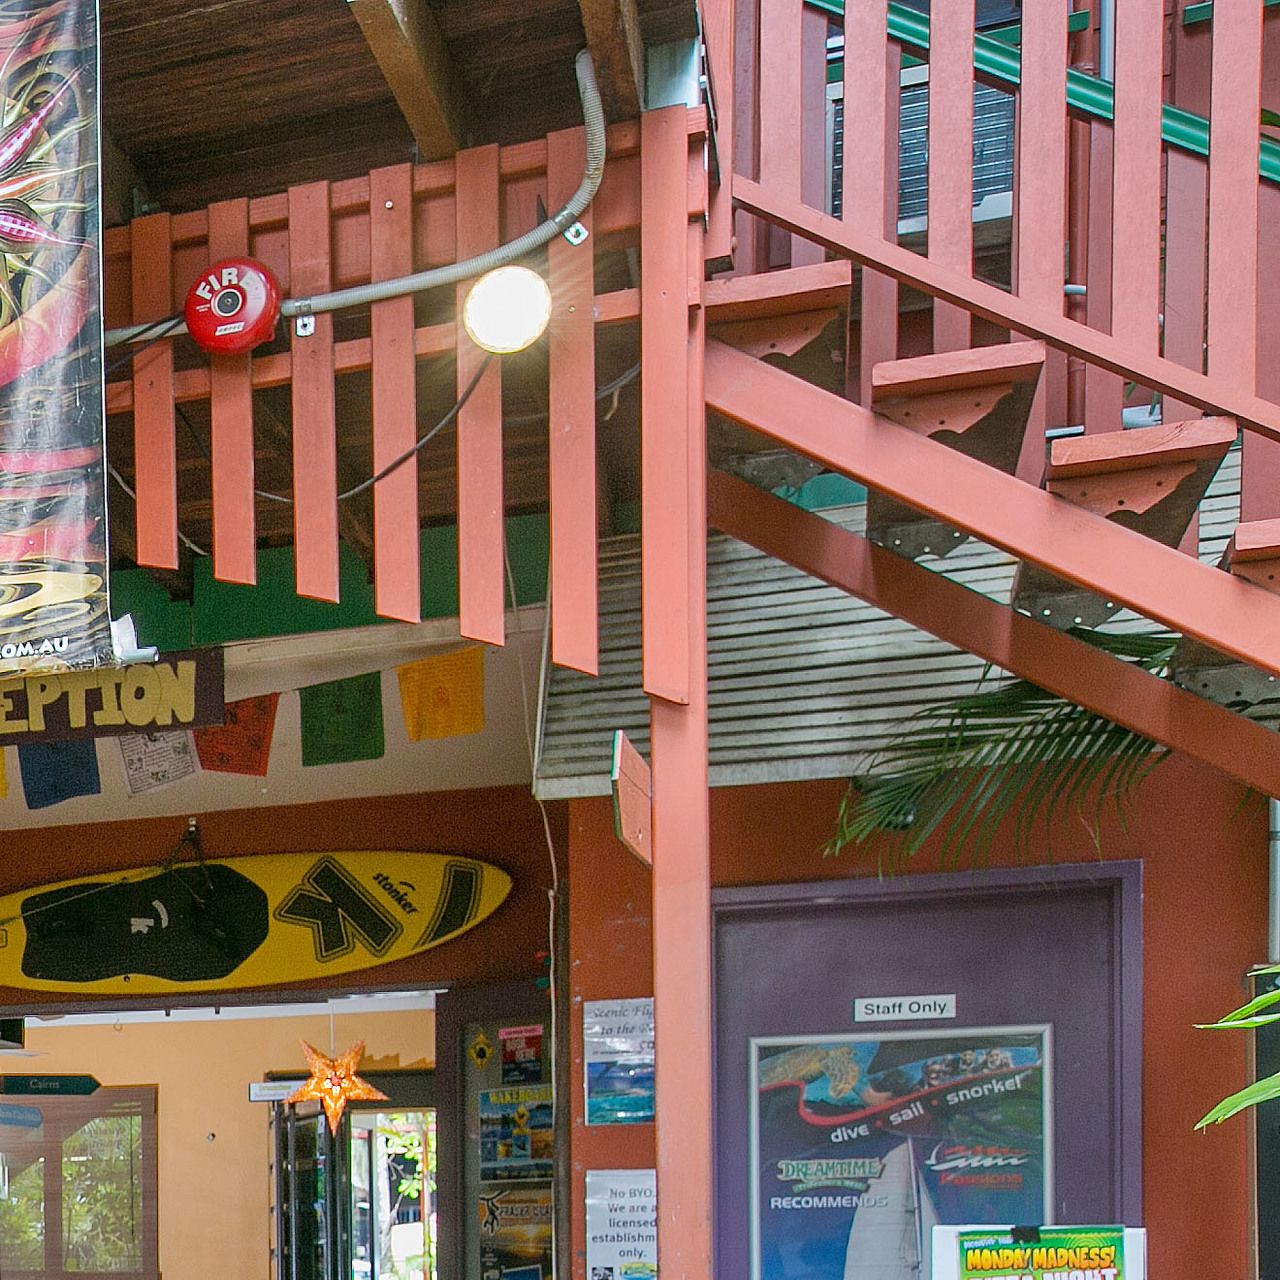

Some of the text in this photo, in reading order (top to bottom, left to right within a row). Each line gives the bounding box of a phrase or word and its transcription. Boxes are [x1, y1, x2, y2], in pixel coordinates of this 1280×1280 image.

[372, 872, 419, 916] stonker
[592, 1006, 628, 1018] Scenic
[864, 1001, 947, 1016] Staff Only
[600, 1026, 613, 1036] to
[616, 1023, 636, 1034] the
[831, 1074, 1024, 1143] dive sail snorkel
[784, 1160, 880, 1179] DREAMTIME
[610, 1188, 625, 1199] No
[608, 1203, 625, 1213] We
[629, 1205, 648, 1213] are
[770, 1195, 889, 1209] RECOMMENDS
[608, 1217, 657, 1228] licensed
[618, 1247, 648, 1259] only.
[966, 1245, 1116, 1270] MONDAY MADNESS!
